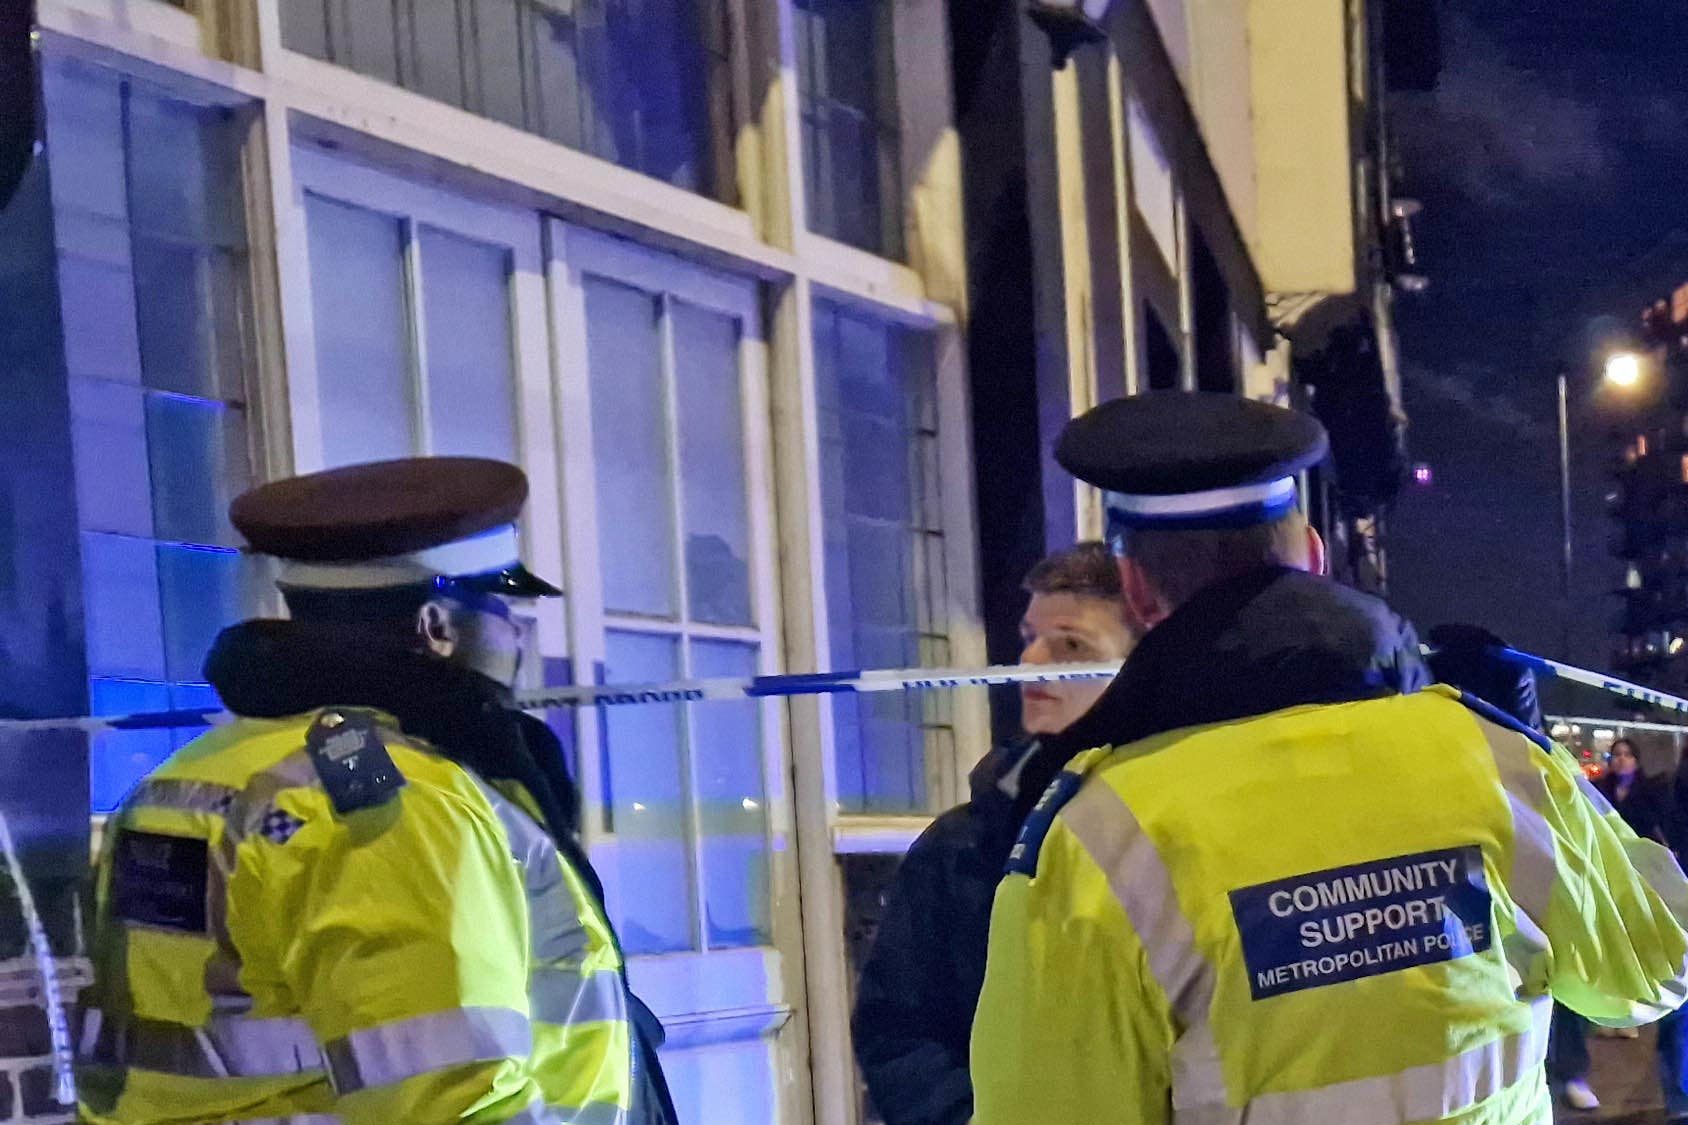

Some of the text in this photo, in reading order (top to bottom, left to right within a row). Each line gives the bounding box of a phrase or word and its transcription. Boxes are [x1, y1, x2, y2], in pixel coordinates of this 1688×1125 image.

[1268, 859, 1457, 918] COMMUNITY
[1300, 896, 1446, 948] SUPPORT
[1257, 923, 1485, 989] METROPOLITAN POCE
